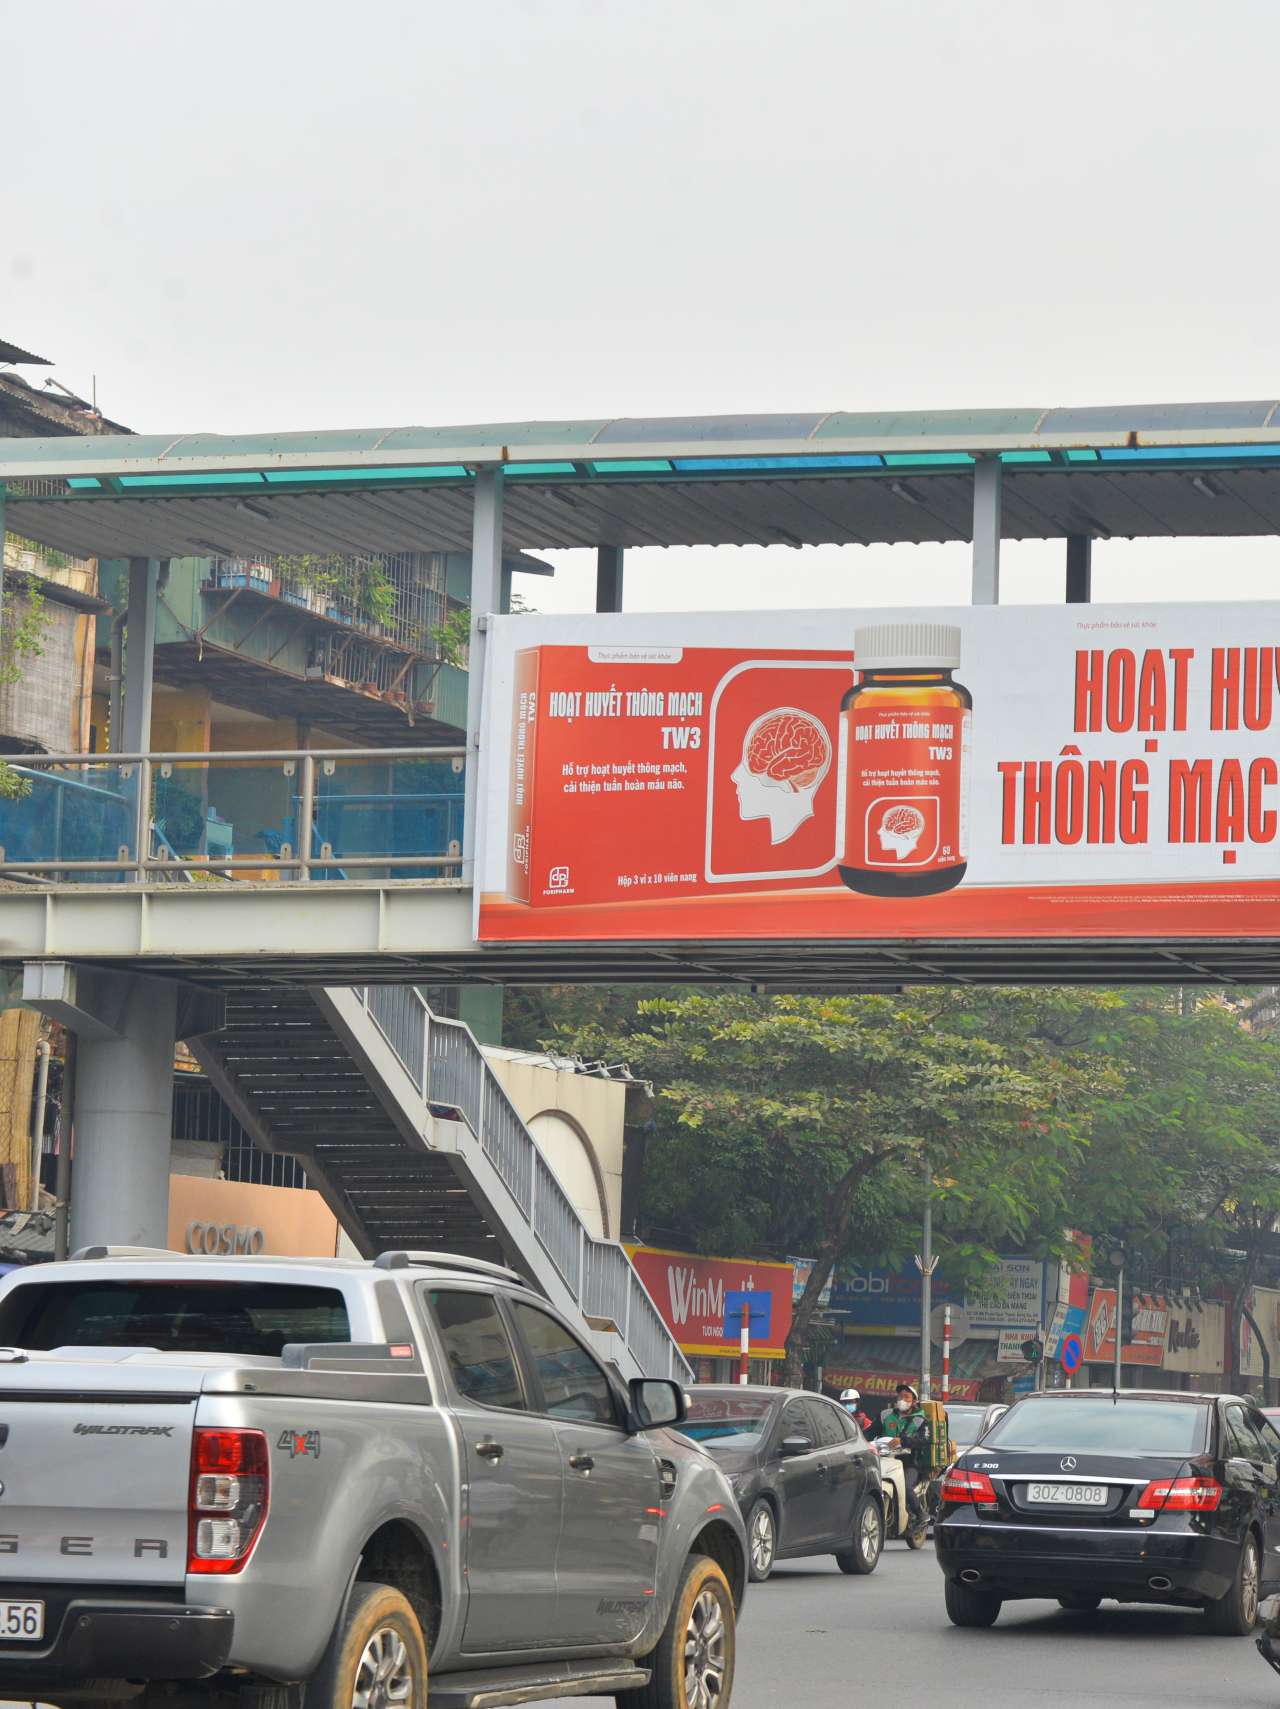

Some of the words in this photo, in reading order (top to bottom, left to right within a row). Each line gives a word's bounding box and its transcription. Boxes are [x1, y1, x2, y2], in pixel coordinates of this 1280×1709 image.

[549, 692, 582, 723] HOẠT
[585, 684, 623, 717] HUYẾT
[626, 688, 664, 717] THÔNG
[667, 692, 703, 721] MẠCH
[1073, 648, 1194, 752] HOẠT
[661, 727, 701, 749] TW3
[856, 725, 873, 743] HOẠT
[875, 719, 900, 739] HUYẾT
[902, 721, 930, 739] THÔNG
[932, 724, 953, 742] MẠCH
[928, 747, 952, 760] TW3
[562, 761, 574, 776] Hỗ
[576, 765, 590, 777] trợ
[591, 764, 610, 776] hoạt
[612, 760, 635, 776] huyết
[637, 762, 660, 776] thông
[663, 762, 687, 775] mạch,
[563, 781, 577, 793] cải
[579, 780, 601, 794] thiện
[603, 777, 622, 792] tuần
[624, 779, 645, 791] hoàn
[647, 778, 665, 790] máu
[667, 778, 685, 790] não.
[997, 744, 1149, 845] THÔNG
[943, 846, 951, 855] 60
[618, 875, 632, 888] Hộp
[633, 875, 639, 885] 3
[653, 874, 662, 884] 10
[663, 873, 679, 883] viên
[680, 873, 697, 884] nang
[185, 1221, 265, 1256] COSMO
[668, 1265, 755, 1325] WinM
[712, 1326, 723, 1337] NGO
[73, 1423, 176, 1437] WILDTRAK
[276, 1430, 320, 1459] 4x4
[1032, 1485, 1102, 1502] 30Z-0808
[0, 1606, 37, 1635] .56
